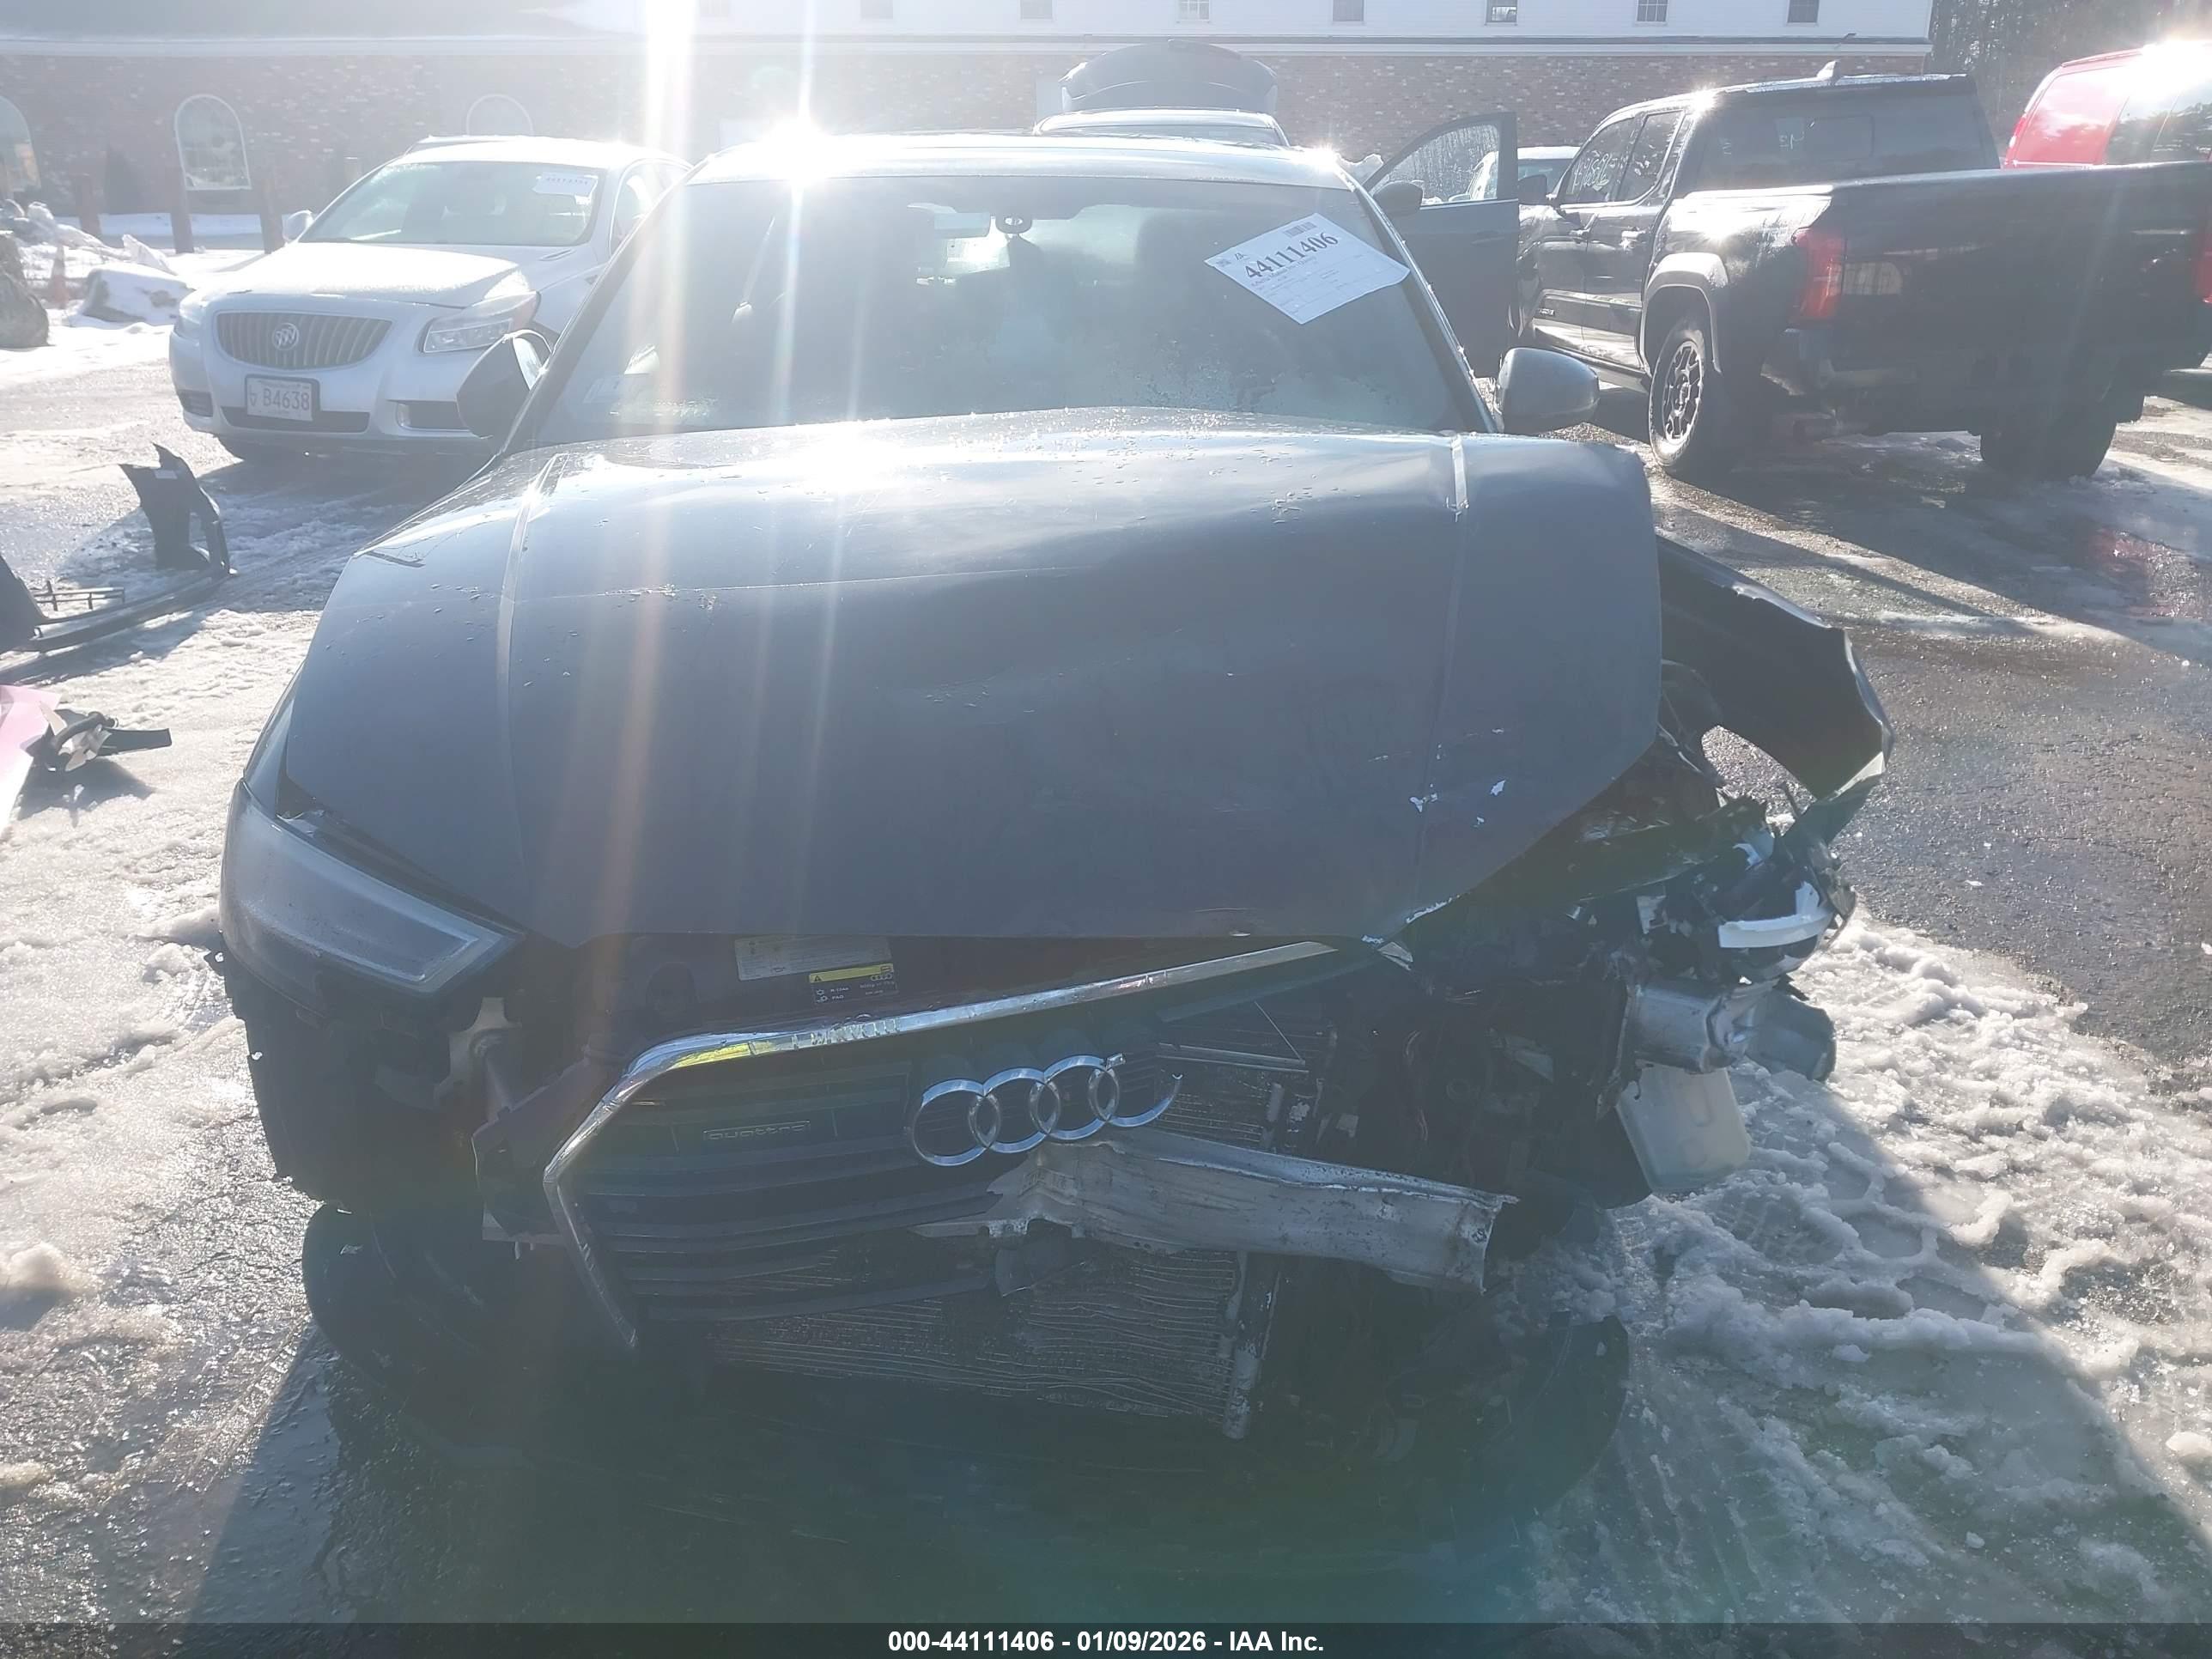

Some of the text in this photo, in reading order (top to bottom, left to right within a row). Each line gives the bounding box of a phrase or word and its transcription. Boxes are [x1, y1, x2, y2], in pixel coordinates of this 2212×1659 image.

[1244, 232, 1339, 279] 44111406
[263, 387, 310, 411] B4638
[708, 1123, 805, 1140] quattro
